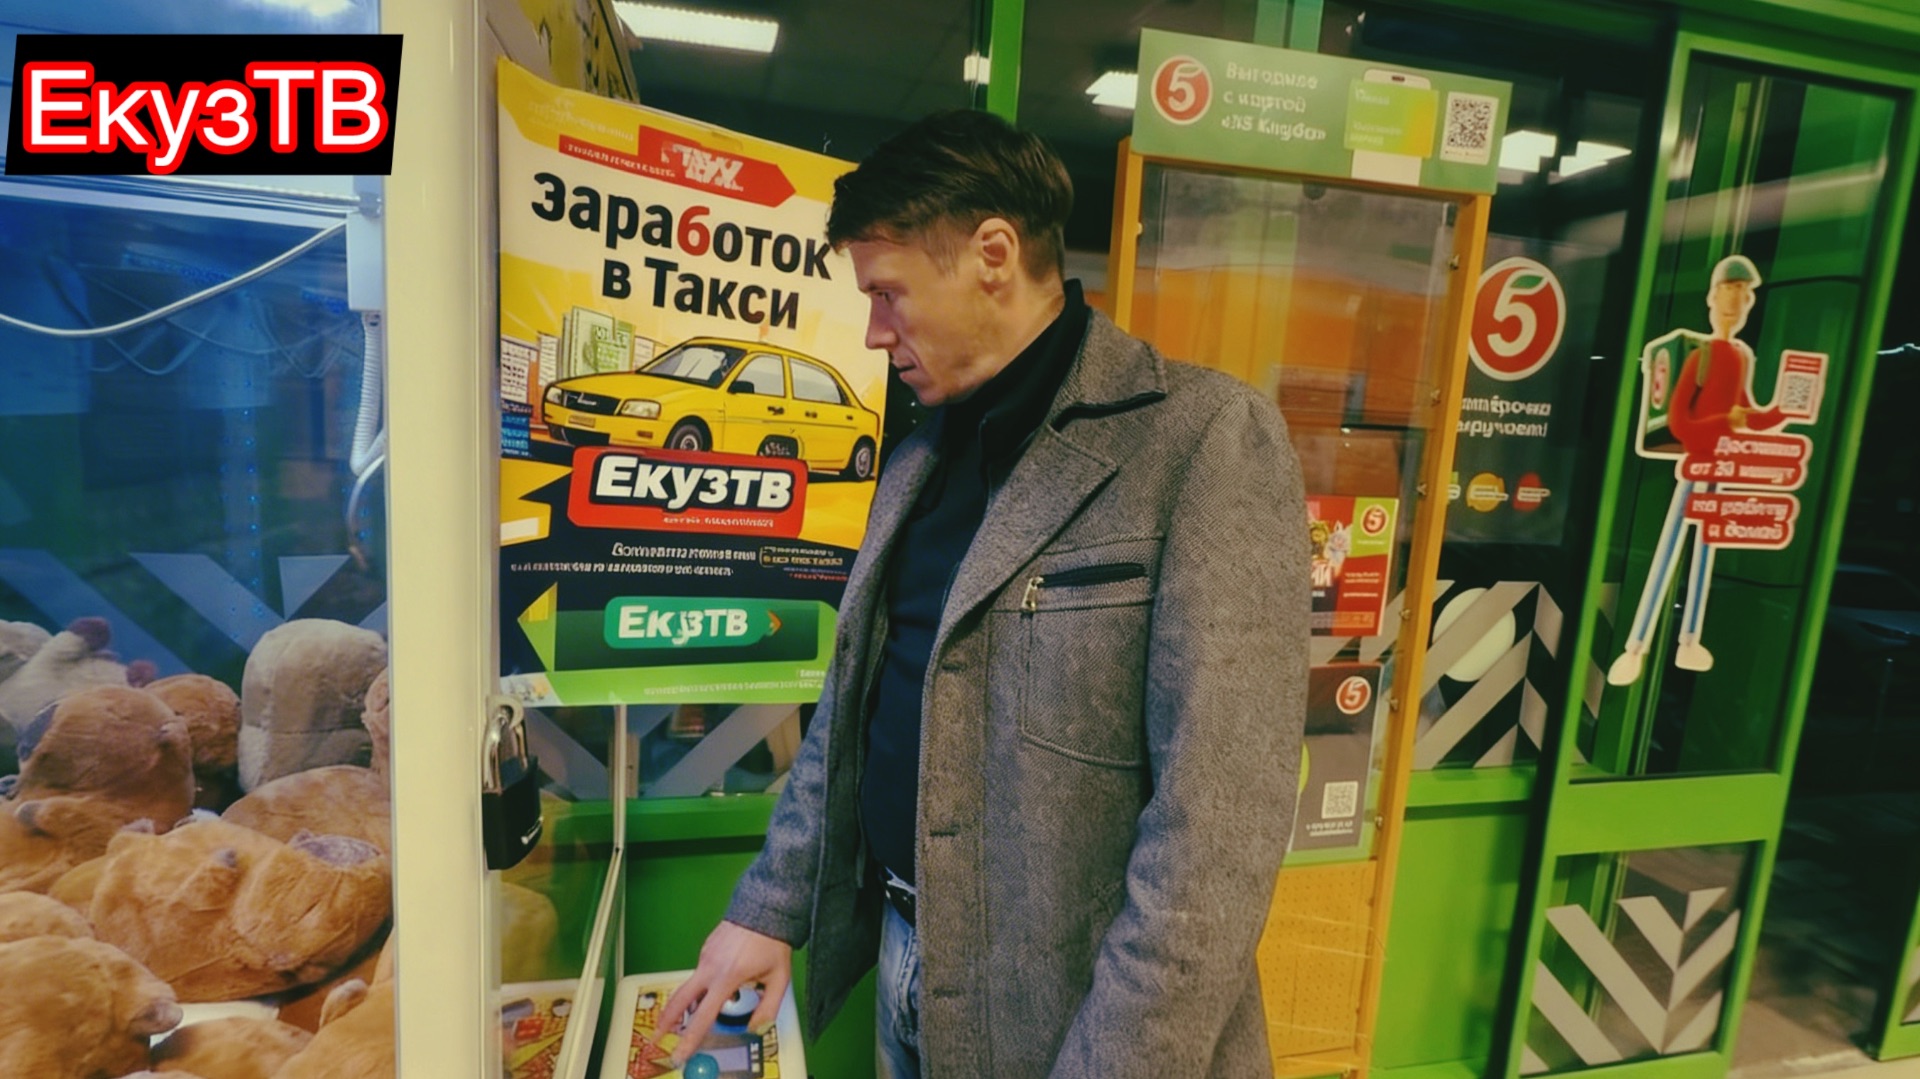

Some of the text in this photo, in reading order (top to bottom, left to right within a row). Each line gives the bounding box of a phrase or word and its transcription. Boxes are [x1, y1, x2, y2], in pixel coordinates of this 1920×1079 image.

[531, 172, 832, 281] Заработок
[602, 256, 799, 330] в Такси
